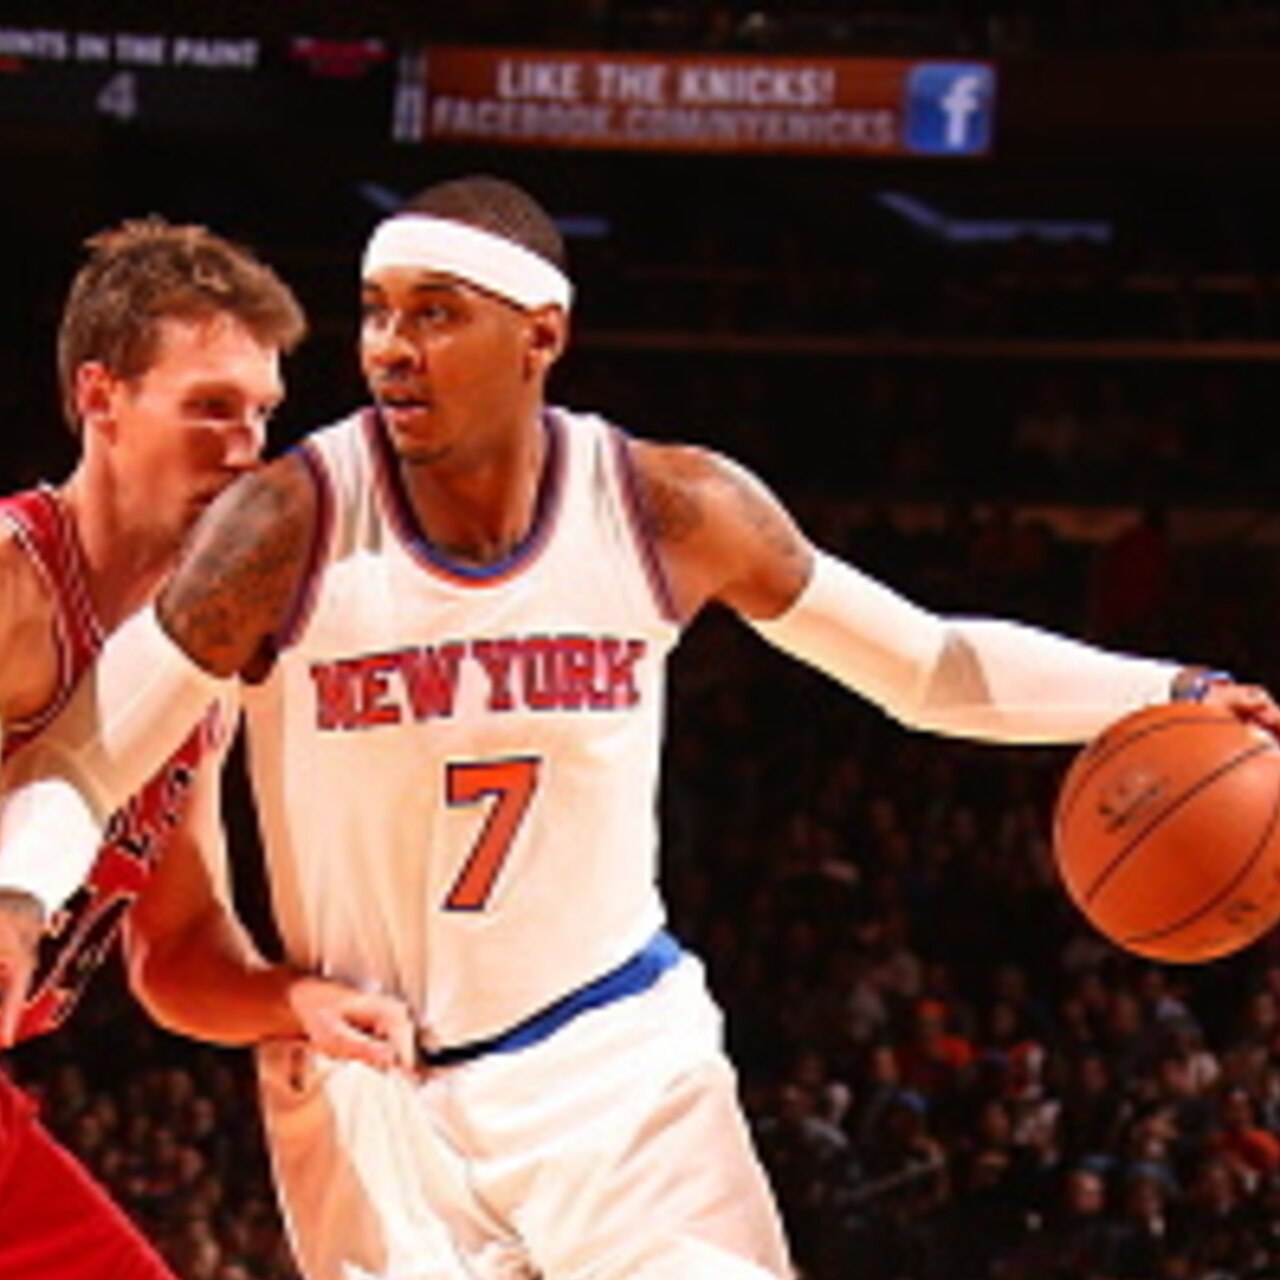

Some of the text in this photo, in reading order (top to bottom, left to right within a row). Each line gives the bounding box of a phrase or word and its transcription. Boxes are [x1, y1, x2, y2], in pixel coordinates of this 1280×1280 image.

[75, 32, 111, 62] IN
[115, 32, 167, 65] THE
[173, 36, 260, 69] PAINT
[96, 70, 136, 119] 4
[496, 57, 836, 106] LIKE THE KNICKS!
[309, 632, 648, 731] NEW YORK
[439, 754, 543, 913] 7
